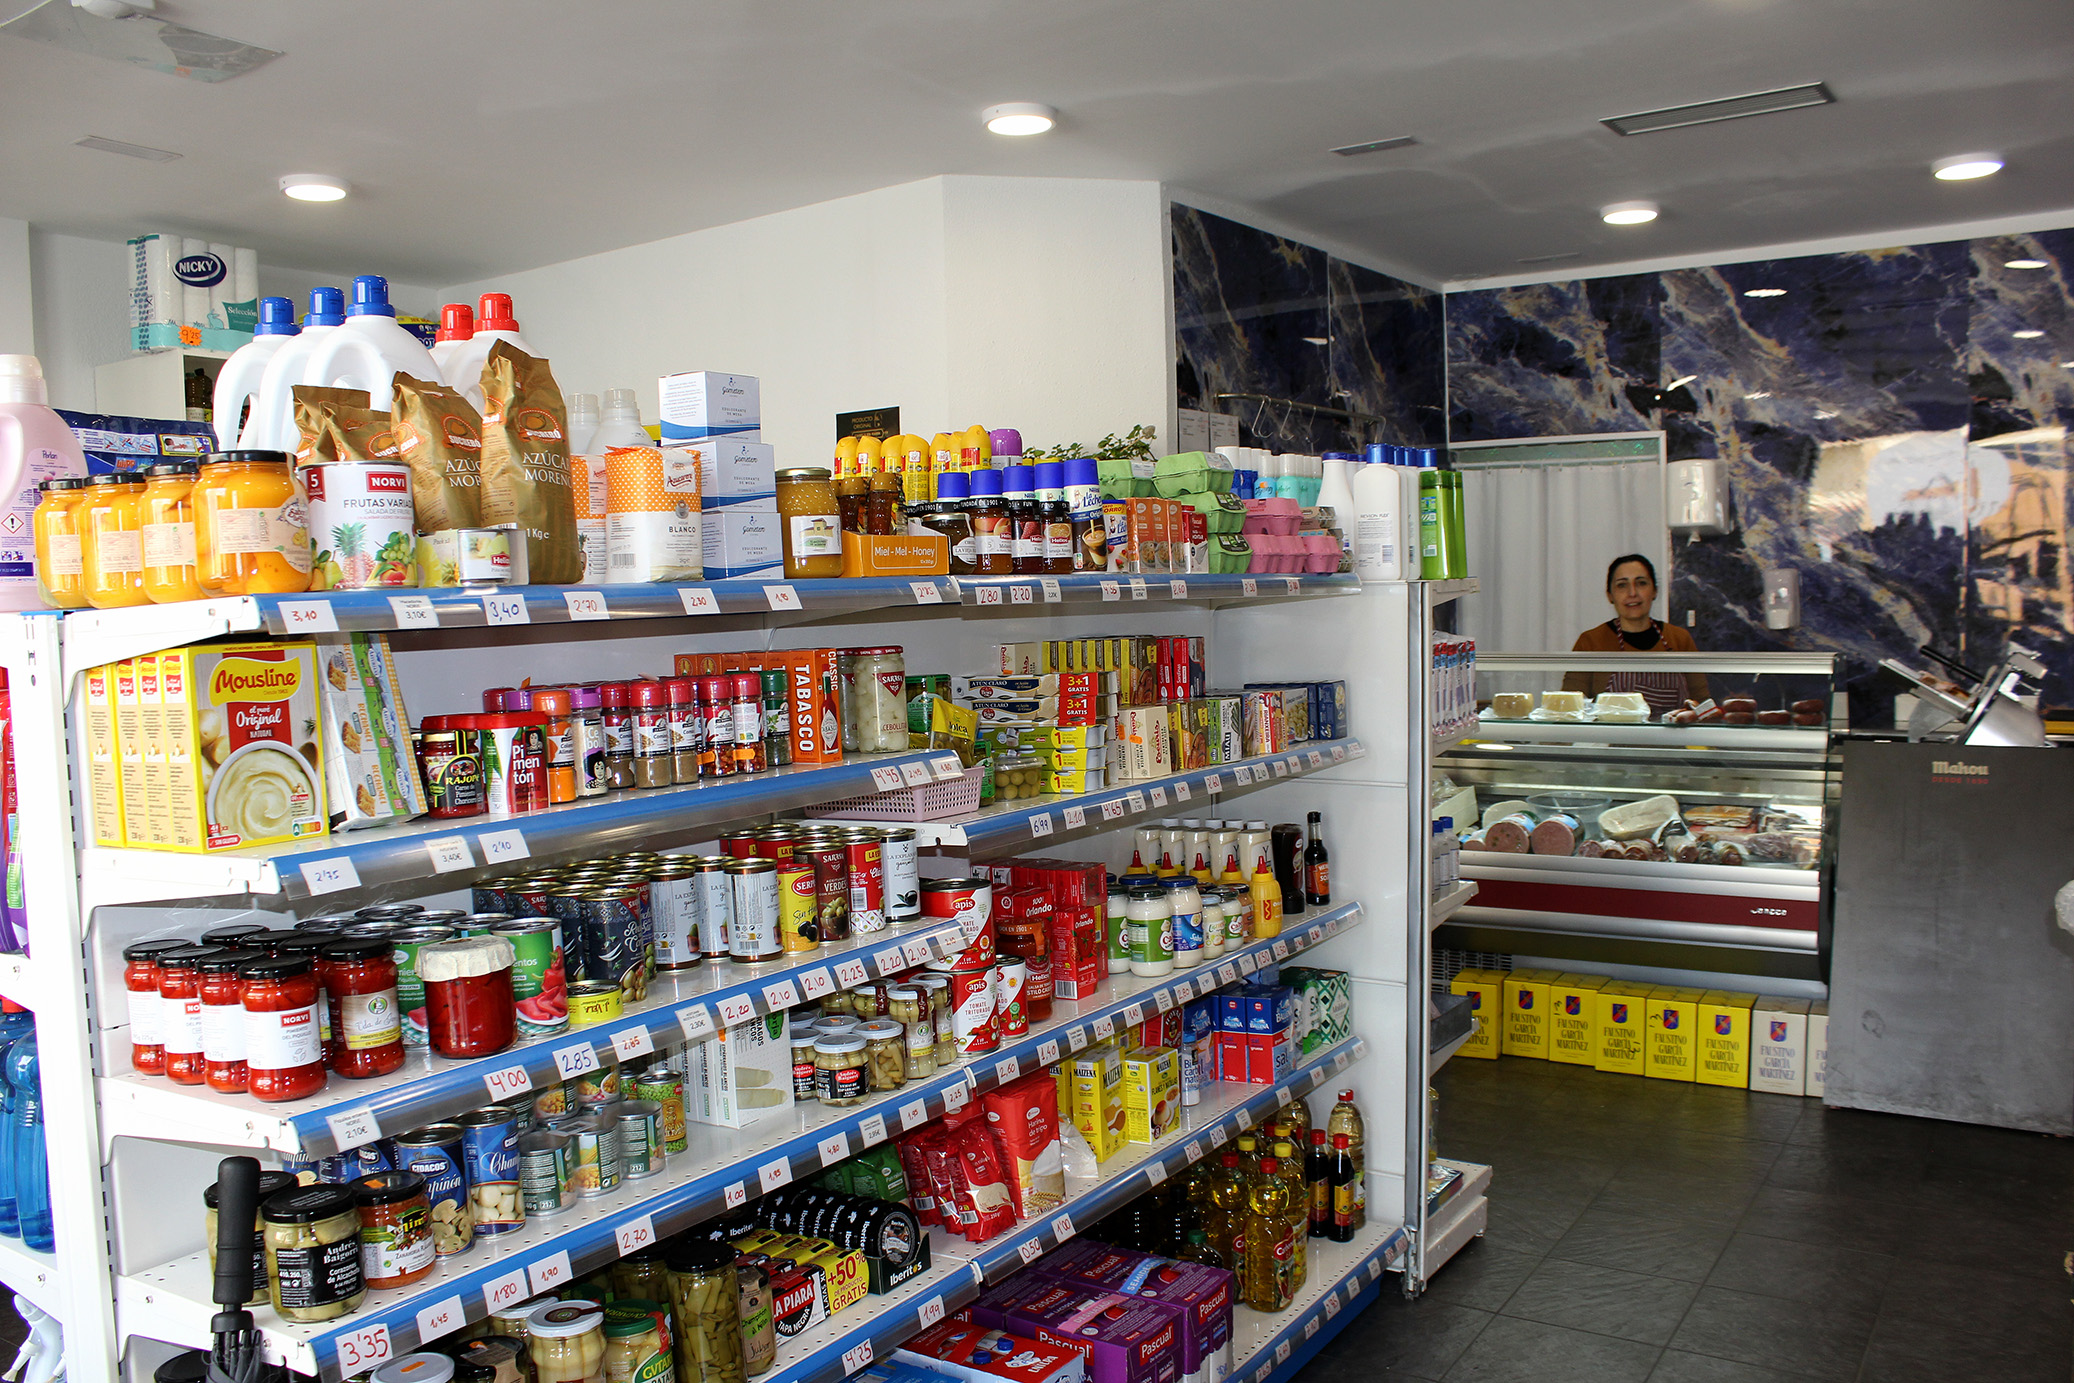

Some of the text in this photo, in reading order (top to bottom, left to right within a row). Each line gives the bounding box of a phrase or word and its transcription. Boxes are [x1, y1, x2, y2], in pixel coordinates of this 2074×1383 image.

[178, 260, 214, 274] NICKY
[228, 306, 257, 318] Selección
[310, 473, 319, 487] 5
[372, 477, 405, 488] NORVI
[343, 499, 385, 508] FRUTAS
[532, 528, 543, 541] Kg
[668, 526, 697, 534] BLANCO
[874, 546, 935, 557] Miel Mel Honey
[980, 590, 998, 604] 2'80
[1012, 588, 1030, 601] 2'20
[489, 602, 519, 622] 3,40
[573, 599, 598, 613] 2'70
[292, 610, 317, 622] 3,10
[405, 611, 427, 620] 3,10€
[828, 651, 839, 691] CLASSIC
[215, 668, 296, 694] Mousline
[1068, 676, 1089, 686] 3+1
[249, 705, 257, 714] el
[794, 664, 814, 752] TABASCO
[1067, 698, 1088, 708] 3+1
[236, 708, 283, 730] Original
[250, 729, 272, 738] NATURAL
[1055, 732, 1061, 744] 1
[512, 745, 525, 759] Pi
[513, 757, 540, 771] men
[1055, 754, 1061, 765] 1
[1932, 761, 1989, 775] Mahou
[513, 770, 535, 785] tón
[875, 768, 900, 784] 4'45
[1054, 776, 1061, 788] 1
[1104, 802, 1122, 817] 4'65
[1033, 817, 1049, 833] 6'99
[492, 841, 511, 853] 2'10
[441, 853, 462, 863] 3,40€
[315, 869, 340, 882] 2'75
[954, 900, 973, 913] apis
[1026, 903, 1052, 917] Orlando
[1075, 918, 1093, 929] Orlando
[908, 946, 927, 962] 2,10
[880, 955, 901, 973] 2,20
[840, 965, 864, 982] 2,25
[804, 976, 825, 992] 2,10
[968, 980, 986, 992] apis
[770, 991, 790, 1005] 2,10
[965, 1007, 991, 1015] TRITURADO
[969, 1001, 987, 1009] TOMATE
[283, 1013, 309, 1024] NORVI
[725, 1004, 749, 1020] 2,20
[1510, 1013, 1541, 1024] FAUSTINO
[1096, 1022, 1112, 1036] 2,40
[1514, 1024, 1537, 1034] GARCÍA
[1557, 1018, 1588, 1031] FAUSTINO
[1510, 1033, 1541, 1045] MARTÍNEZ
[1561, 1029, 1584, 1041] GARCÍA
[1604, 1027, 1635, 1038] FAUSTINO
[1654, 1033, 1687, 1045] FAUSTINO
[623, 1037, 640, 1050] 2,85
[1556, 1039, 1589, 1051] MARTÍNEZ
[1607, 1038, 1631, 1049] GARCÍA
[1658, 1044, 1683, 1055] GARCÍA
[1706, 1039, 1739, 1051] FAUSTINO
[1041, 1045, 1057, 1060] 1,40
[1710, 1050, 1735, 1061] GARCÍA
[1760, 1045, 1795, 1058] FAUSTINO
[1157, 1059, 1171, 1072] MAIZENA
[1185, 1060, 1192, 1068] Bi
[1653, 1054, 1687, 1067] MARTÍNEZ
[1705, 1060, 1739, 1073] MARTÍNEZ
[1764, 1057, 1790, 1069] GARCÍA
[1000, 1063, 1016, 1078] 2,60
[1073, 1069, 1096, 1078] MAIZENA
[1103, 1064, 1123, 1089] MAIZENA
[1759, 1068, 1795, 1081] MARTÍNEZ
[490, 1069, 527, 1092] 4'00
[1027, 1117, 1045, 1129] Harina
[345, 1126, 368, 1139] 2,10€
[1029, 1123, 1048, 1137] de trigo
[411, 1162, 446, 1173] CIDACOS
[727, 1189, 744, 1204] 1,00
[1057, 1219, 1071, 1233] 1'00
[622, 1228, 647, 1249] 2,70
[327, 1241, 356, 1256] Andrés
[1022, 1238, 1041, 1258] 0'50
[890, 1260, 922, 1286] Iberitos
[1084, 1255, 1121, 1278] Pascual
[784, 1286, 814, 1312] PIARA
[833, 1282, 867, 1311] GRATIS
[1027, 1288, 1067, 1311] Pascual
[1199, 1287, 1227, 1317] Pascual
[923, 1304, 940, 1320] 1,99
[430, 1314, 448, 1328] 1,45
[777, 1306, 811, 1334] TAPA NEGRA
[343, 1329, 389, 1366] 3'35
[1141, 1326, 1172, 1359] Pascual
[846, 1343, 872, 1367] 4'25
